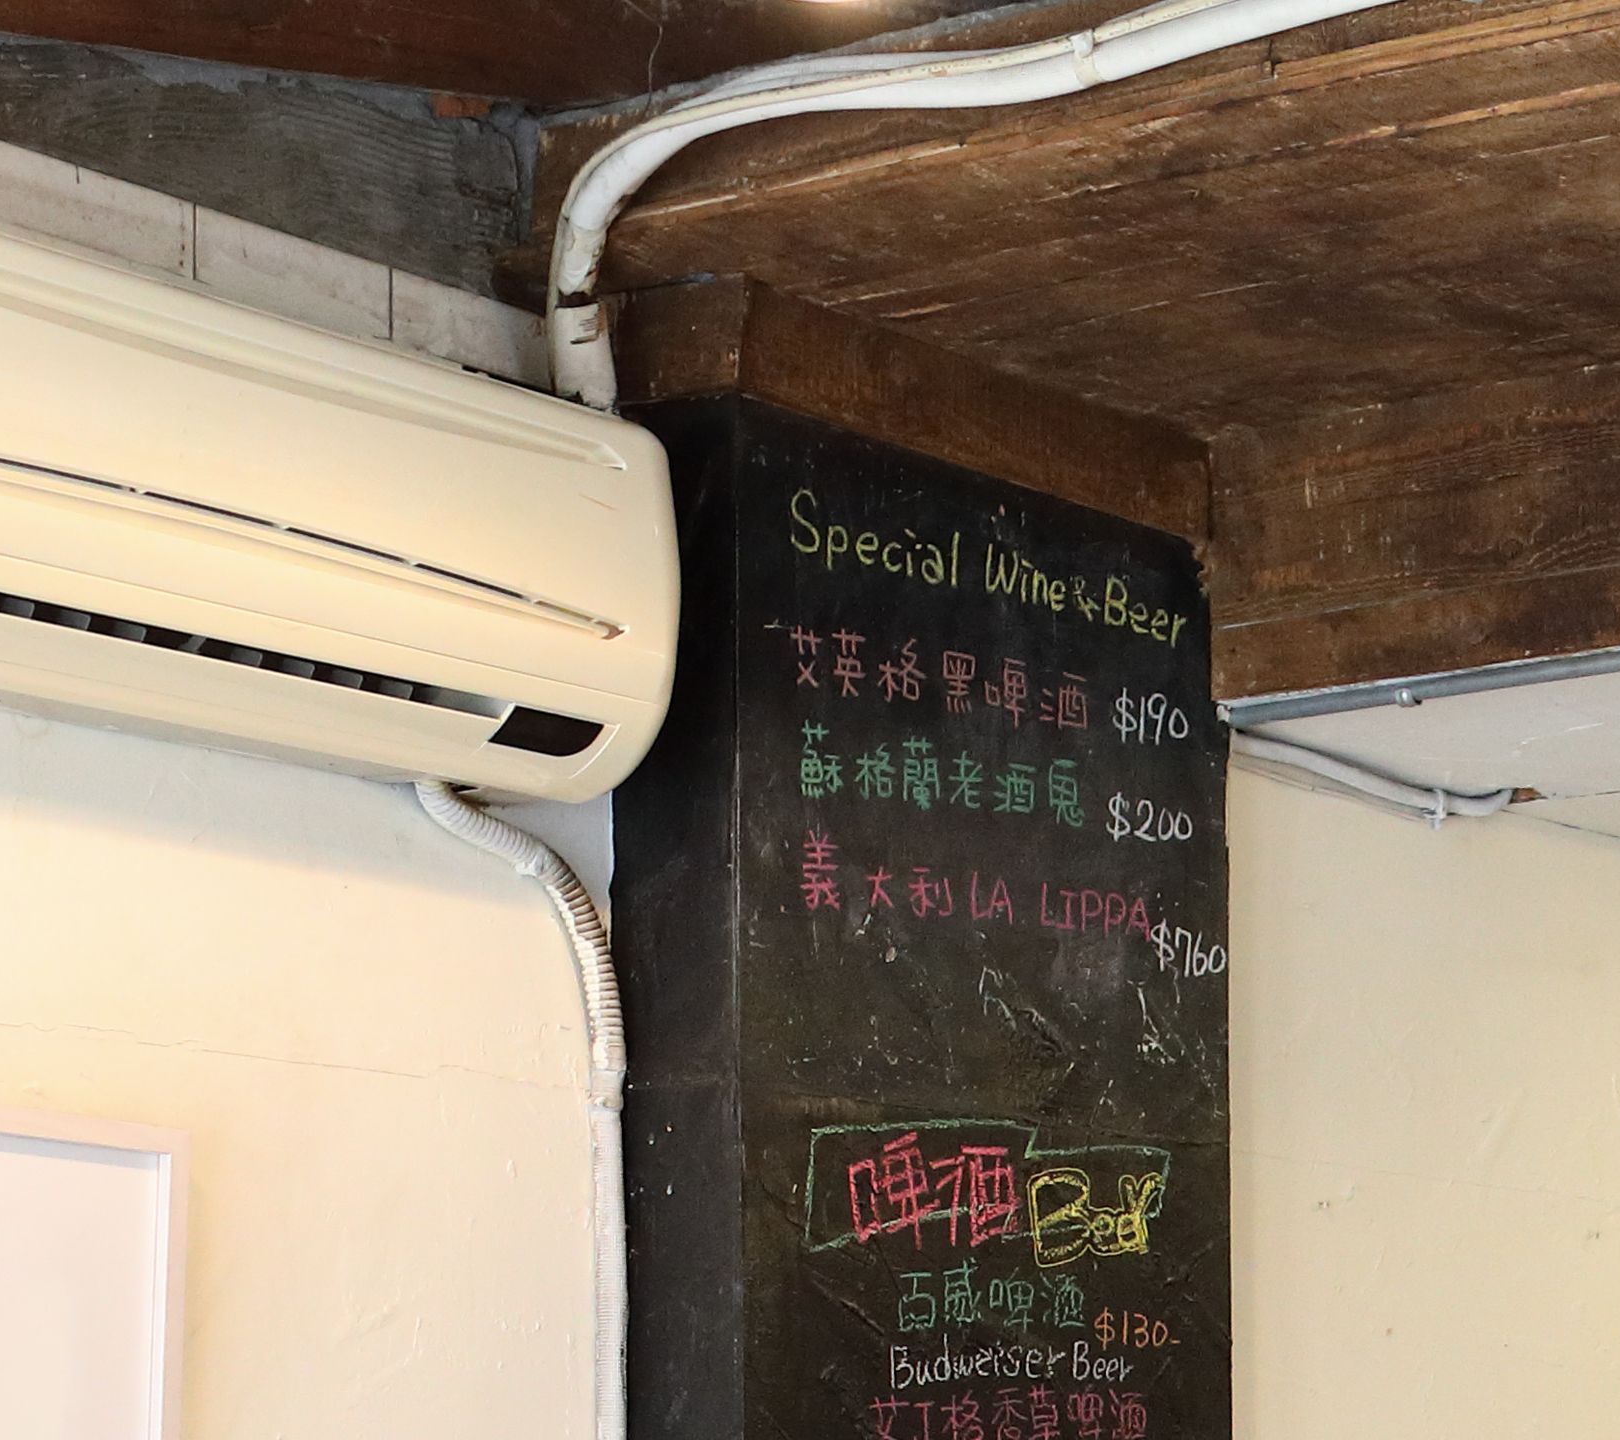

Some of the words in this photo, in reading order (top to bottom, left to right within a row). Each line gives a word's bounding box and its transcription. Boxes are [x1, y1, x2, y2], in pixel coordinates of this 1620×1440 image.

[790, 489, 959, 586] Special
[1112, 688, 1188, 747] $190
[1105, 792, 1193, 842] $200
[1151, 919, 1226, 978] $760
[847, 1130, 1021, 1250] 啤酒
[897, 1254, 1085, 1333] 百威啤酒
[890, 1333, 1065, 1390] Budweiser
[1072, 1339, 1134, 1383] Beer
